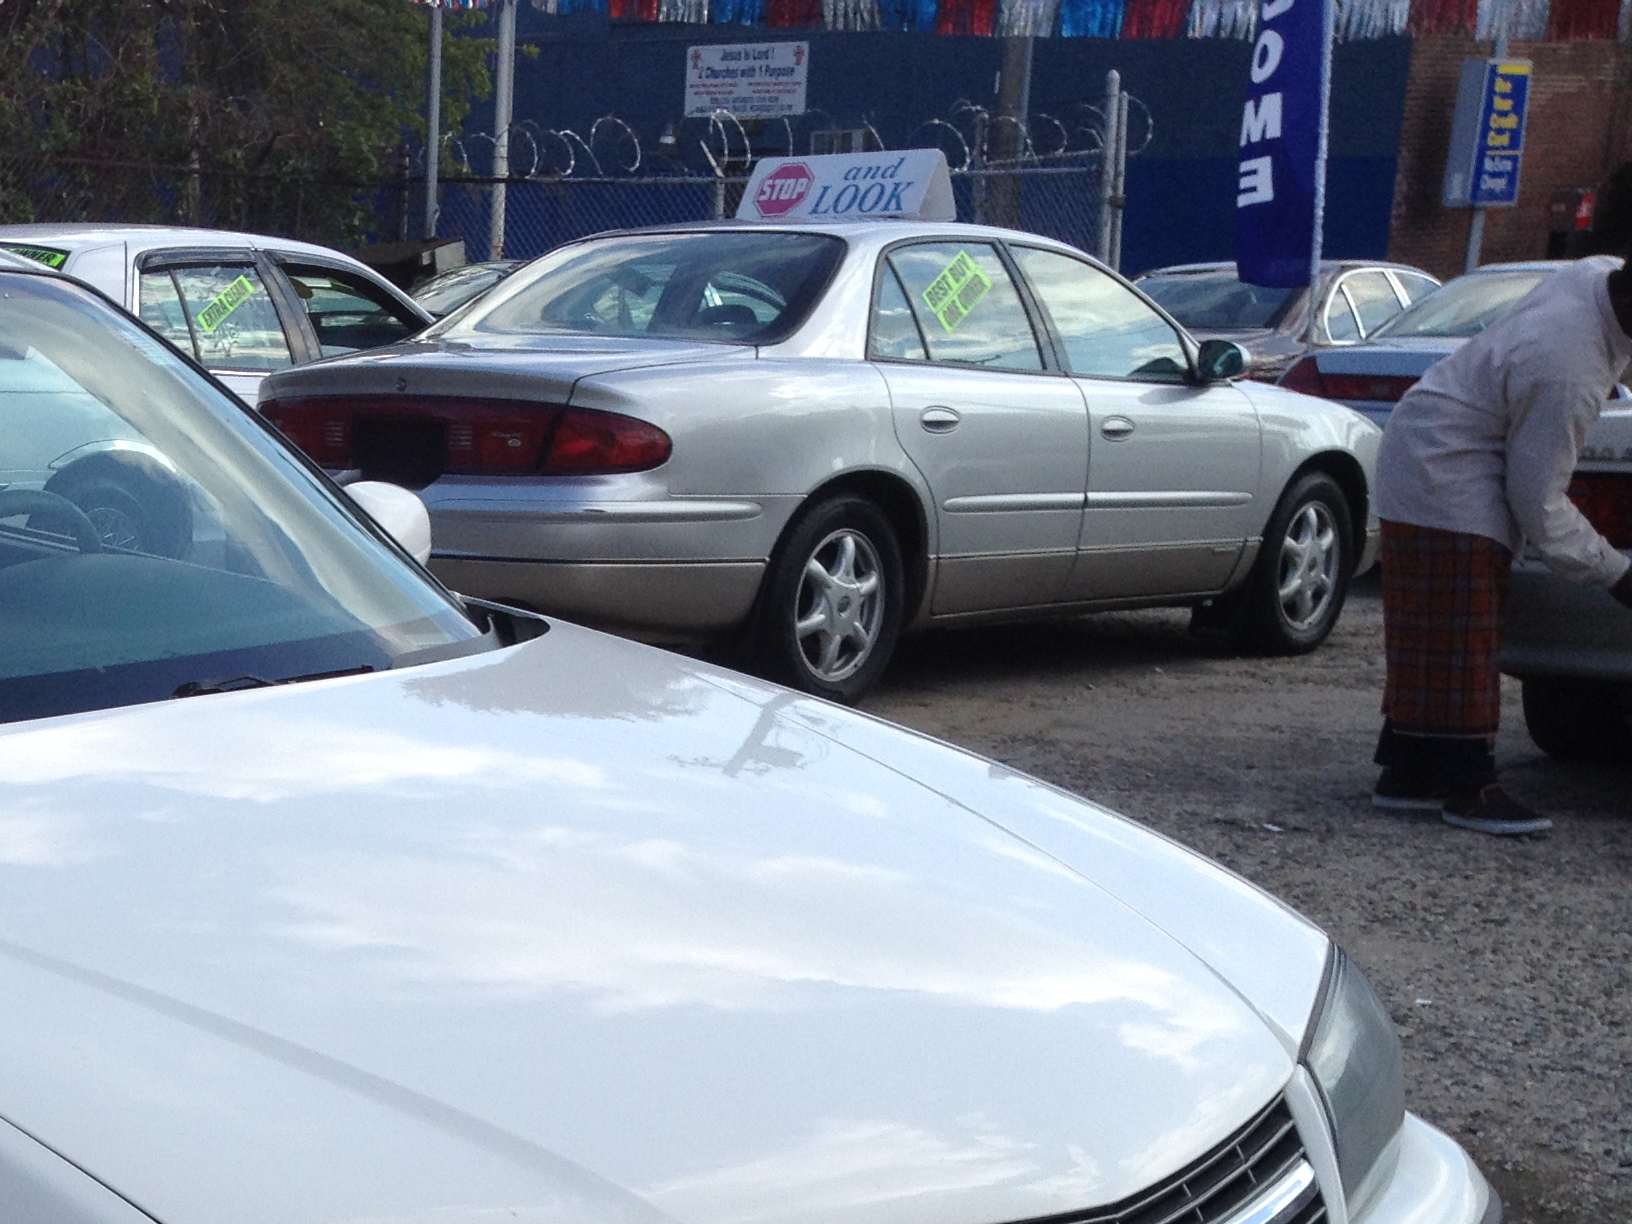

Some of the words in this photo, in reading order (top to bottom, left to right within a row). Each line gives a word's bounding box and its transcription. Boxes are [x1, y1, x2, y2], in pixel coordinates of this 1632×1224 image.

[843, 156, 906, 182] and
[758, 178, 809, 201] STOP
[808, 181, 915, 215] LOOK
[926, 274, 953, 308] BEST
[948, 254, 970, 283] BUY
[201, 297, 229, 328] EXTRA
